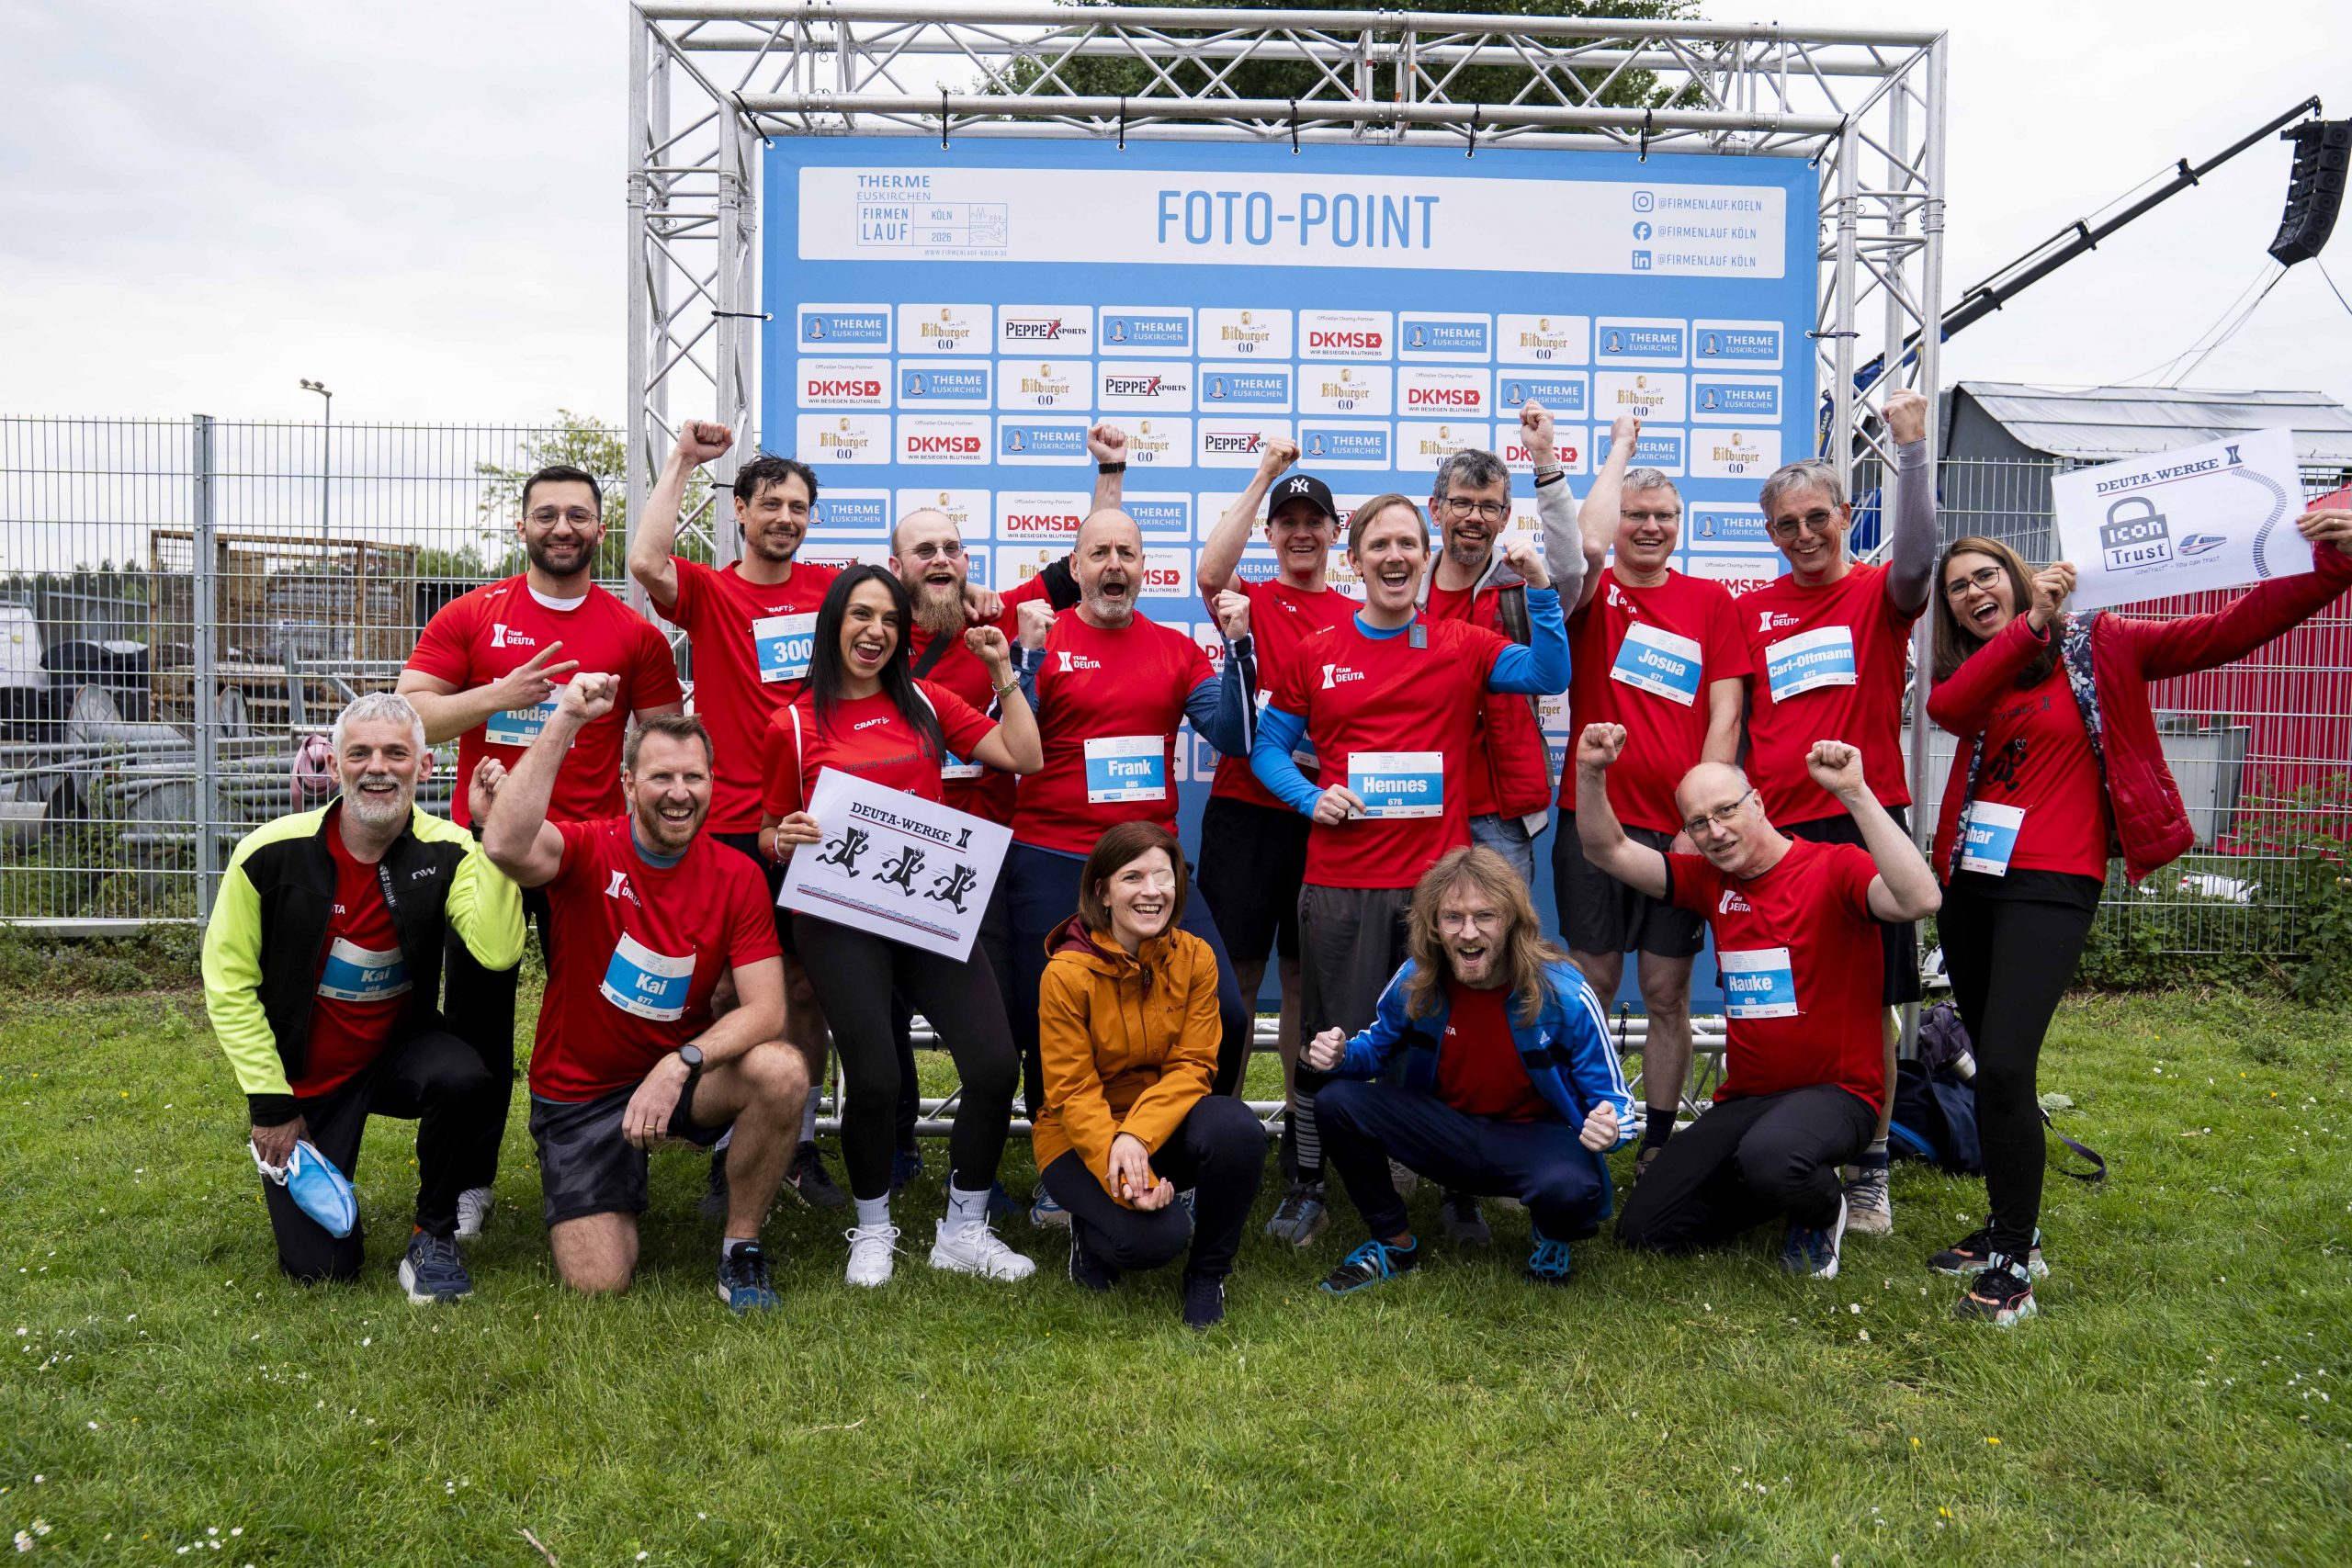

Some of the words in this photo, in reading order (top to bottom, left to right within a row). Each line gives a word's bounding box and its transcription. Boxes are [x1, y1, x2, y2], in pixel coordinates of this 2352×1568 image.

[858, 175, 930, 188] THERME
[857, 192, 931, 200] EUSKIRCHEN
[1659, 198, 1762, 210] @FIRMENLAUF.KOELN
[864, 209, 908, 219] FIRMEN
[932, 209, 952, 220] KÖLN
[1159, 190, 1440, 249] FOTO-POINT
[863, 223, 908, 241] LAUF
[932, 232, 951, 242] 2026
[1658, 226, 1727, 238] @FIRMENLAUF
[1732, 227, 1757, 239] KÖLN
[1658, 254, 1727, 266] @FIRMENLAUF
[1731, 254, 1756, 266] KÖLN
[832, 319, 881, 329] THERME
[1006, 319, 1061, 339] PEPPEX
[1134, 321, 1182, 333] THERME
[921, 322, 969, 339] Bitburger
[1221, 325, 1270, 343] Bitburger
[1433, 328, 1481, 338] THERME
[1310, 332, 1364, 347] DKMS
[1520, 333, 1567, 349] Bitburger
[1630, 333, 1677, 344] THERME
[1726, 336, 1773, 345] THERME
[933, 376, 981, 385] THERME
[1021, 378, 1069, 395] Bitburger
[1106, 375, 1161, 396] PEPPEX
[1234, 379, 1282, 389] THERME
[808, 381, 863, 396] DKMS
[1321, 382, 1369, 400] Bitburger
[1531, 386, 1578, 395] THERME
[1408, 389, 1462, 404] DKMS
[1617, 389, 1664, 406] Bitburger
[1725, 390, 1772, 400] THERME
[820, 432, 868, 448] Bitburger
[1032, 432, 1081, 442] THERME
[1333, 436, 1381, 446] THERME
[908, 437, 962, 452] DKMS
[1636, 443, 1675, 452] HERME
[1713, 447, 1759, 463] Bitburger
[2096, 458, 2219, 493] DEUTA-WERKE
[831, 505, 879, 513] THERME
[1133, 508, 1181, 517] THERME
[1008, 515, 1062, 531] DKMS
[1238, 565, 1279, 573] HERME
[507, 637, 535, 646] DEUTA
[1074, 660, 1101, 669] DEUTA
[1638, 649, 1686, 676] Josua
[1769, 649, 1851, 678] Carl-Oltmann
[1336, 672, 1364, 682] DEUTA
[1650, 672, 1663, 682] 671
[1804, 670, 1816, 679] 672
[854, 718, 881, 730] CRAFT
[1108, 759, 1151, 776] Frank
[1363, 776, 1427, 793] Hennes
[851, 802, 952, 843] DEUTA-WERKE
[361, 967, 390, 983] Kai
[636, 973, 668, 996] Kai
[1729, 976, 1772, 991] Hauke
[637, 996, 653, 1005] 677
